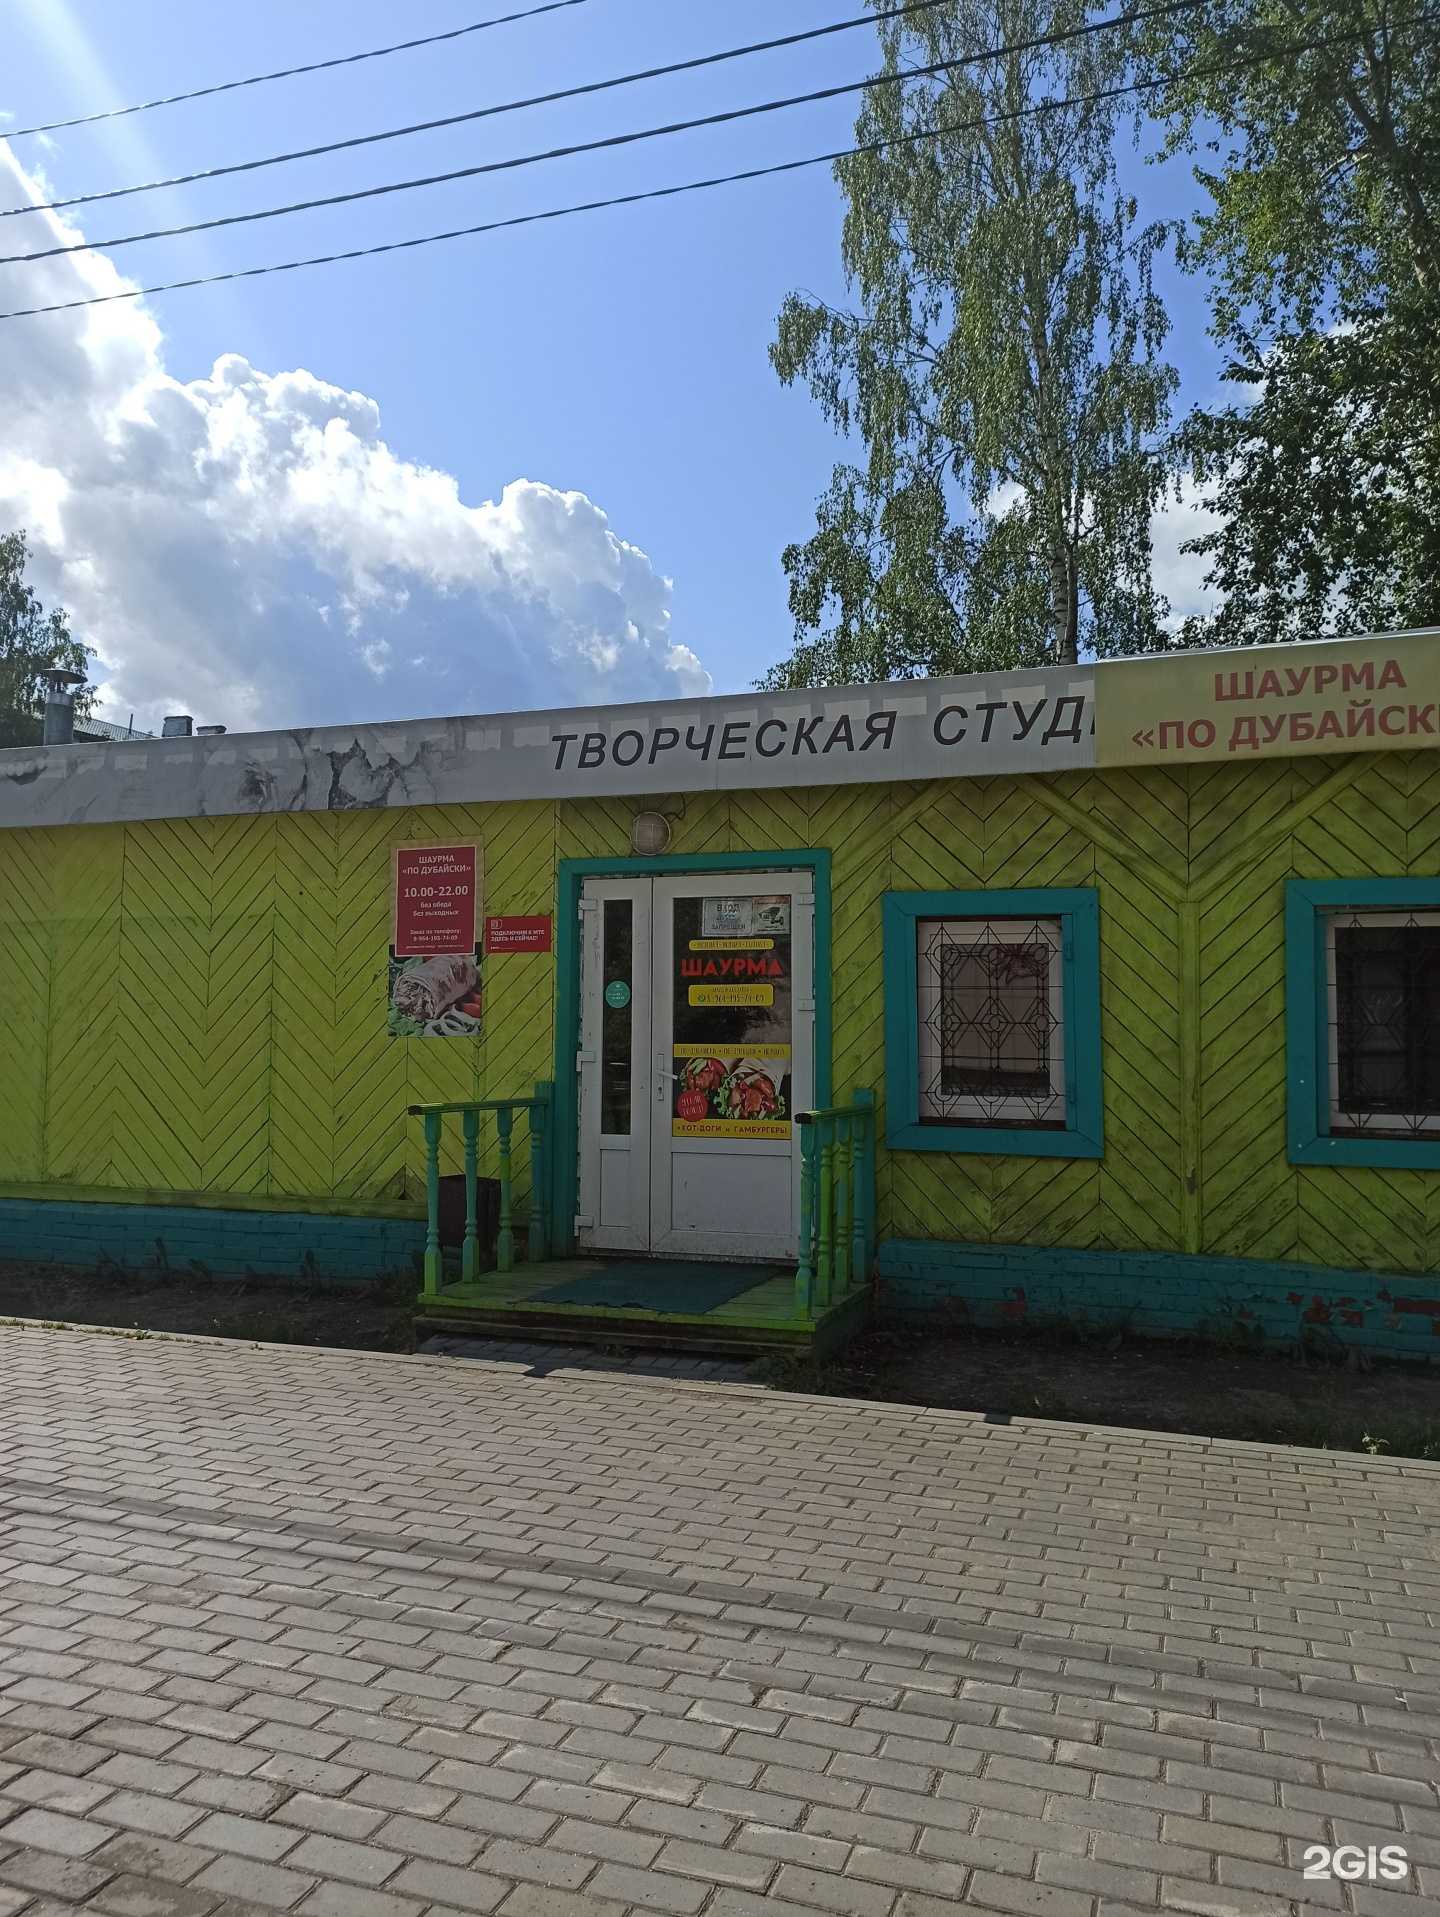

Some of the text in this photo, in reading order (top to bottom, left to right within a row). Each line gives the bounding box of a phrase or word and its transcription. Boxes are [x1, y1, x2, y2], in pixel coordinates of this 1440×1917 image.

[1214, 659, 1407, 702] ШАУРМА
[551, 696, 1096, 770] ТВОРЧЕСКАЯ СТУД
[1131, 697, 1440, 752] «ПО ДУБАЙСК
[418, 855, 455, 864] ШАУРМА
[403, 885, 469, 898] 10.00-22.00
[681, 958, 784, 977] ШАУРМА
[734, 1125, 787, 1135] ГАМБУРГЕРЫ
